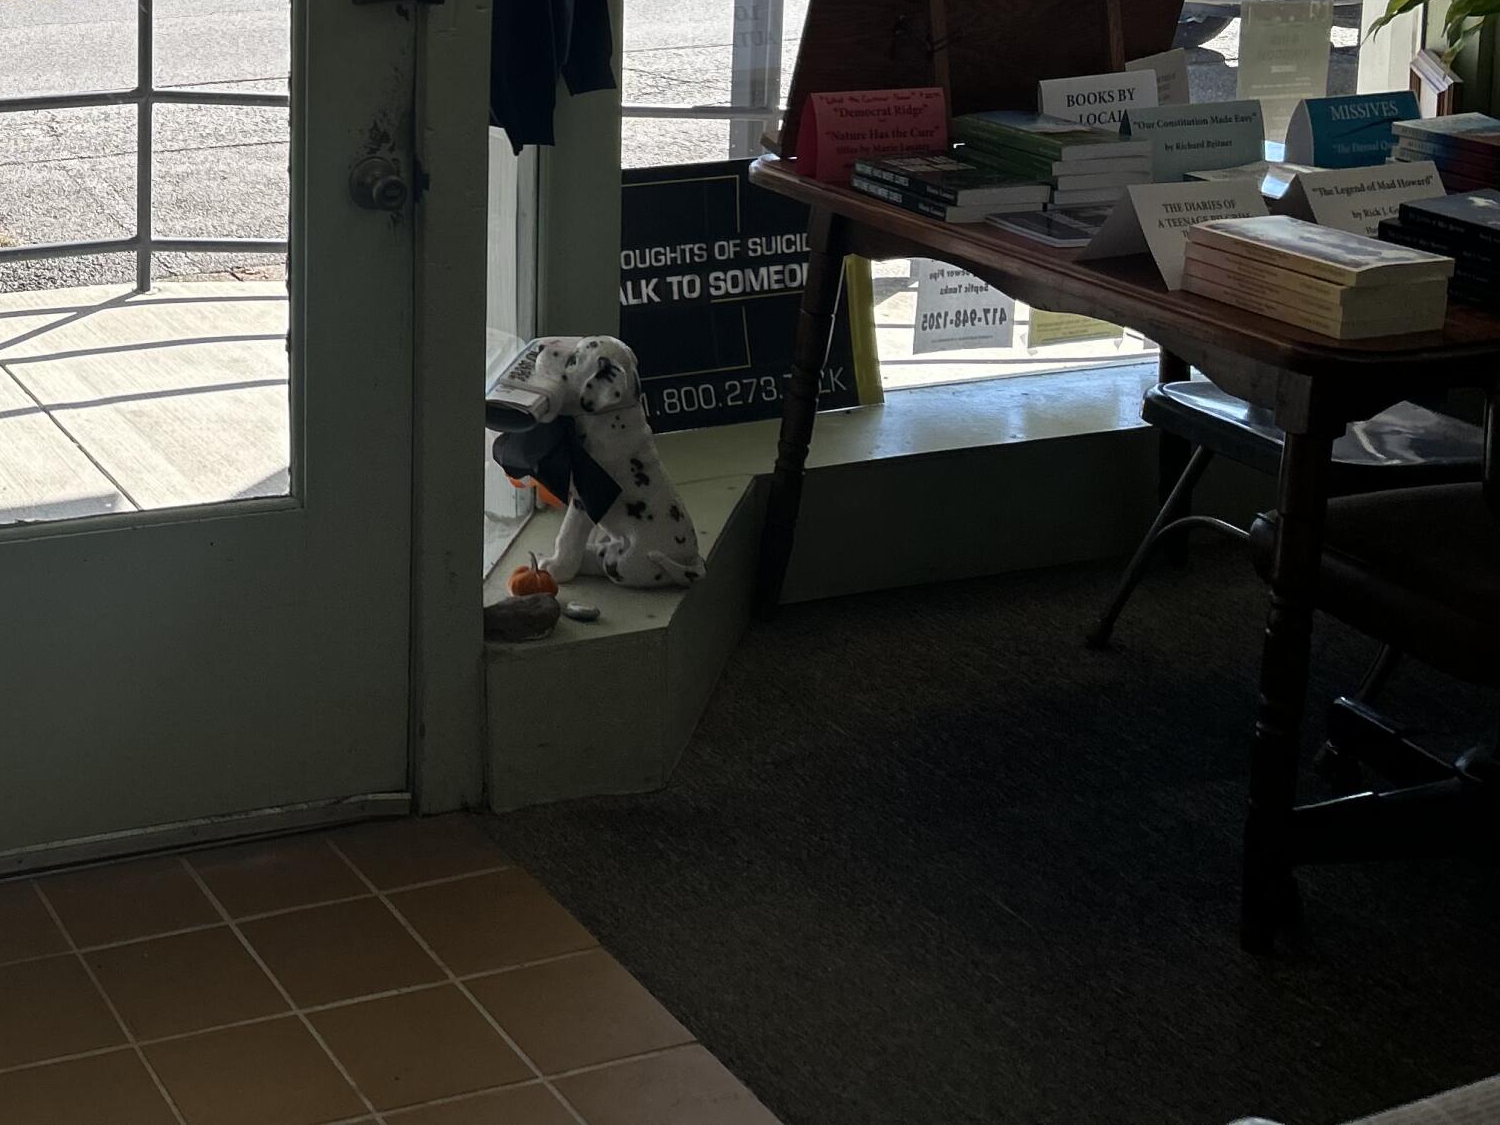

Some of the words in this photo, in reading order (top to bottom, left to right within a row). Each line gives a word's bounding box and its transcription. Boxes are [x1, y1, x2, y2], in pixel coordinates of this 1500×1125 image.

[1067, 90, 1115, 107] BOOKS
[1117, 87, 1137, 102] BY
[1330, 99, 1399, 122] MISSIVES
[1156, 117, 1208, 128] Constitution
[1210, 115, 1233, 125] Made
[891, 127, 907, 138] the
[1164, 142, 1174, 152] by
[1335, 183, 1366, 197] Legend
[1366, 181, 1377, 192] of
[1377, 180, 1397, 191] Mad
[1162, 202, 1184, 214] THE
[1184, 199, 1223, 212] DIARIES
[1223, 199, 1236, 209] OF
[1351, 210, 1362, 220] by
[1362, 206, 1381, 218] Rick
[1157, 218, 1165, 228] A
[1165, 215, 1209, 228] TEENAGE
[620, 243, 708, 270] OUGHTS
[713, 239, 741, 260] OF
[747, 233, 811, 257] SUICI
[620, 278, 661, 306] LK
[666, 273, 701, 300] TO
[708, 262, 809, 296] SOMEO
